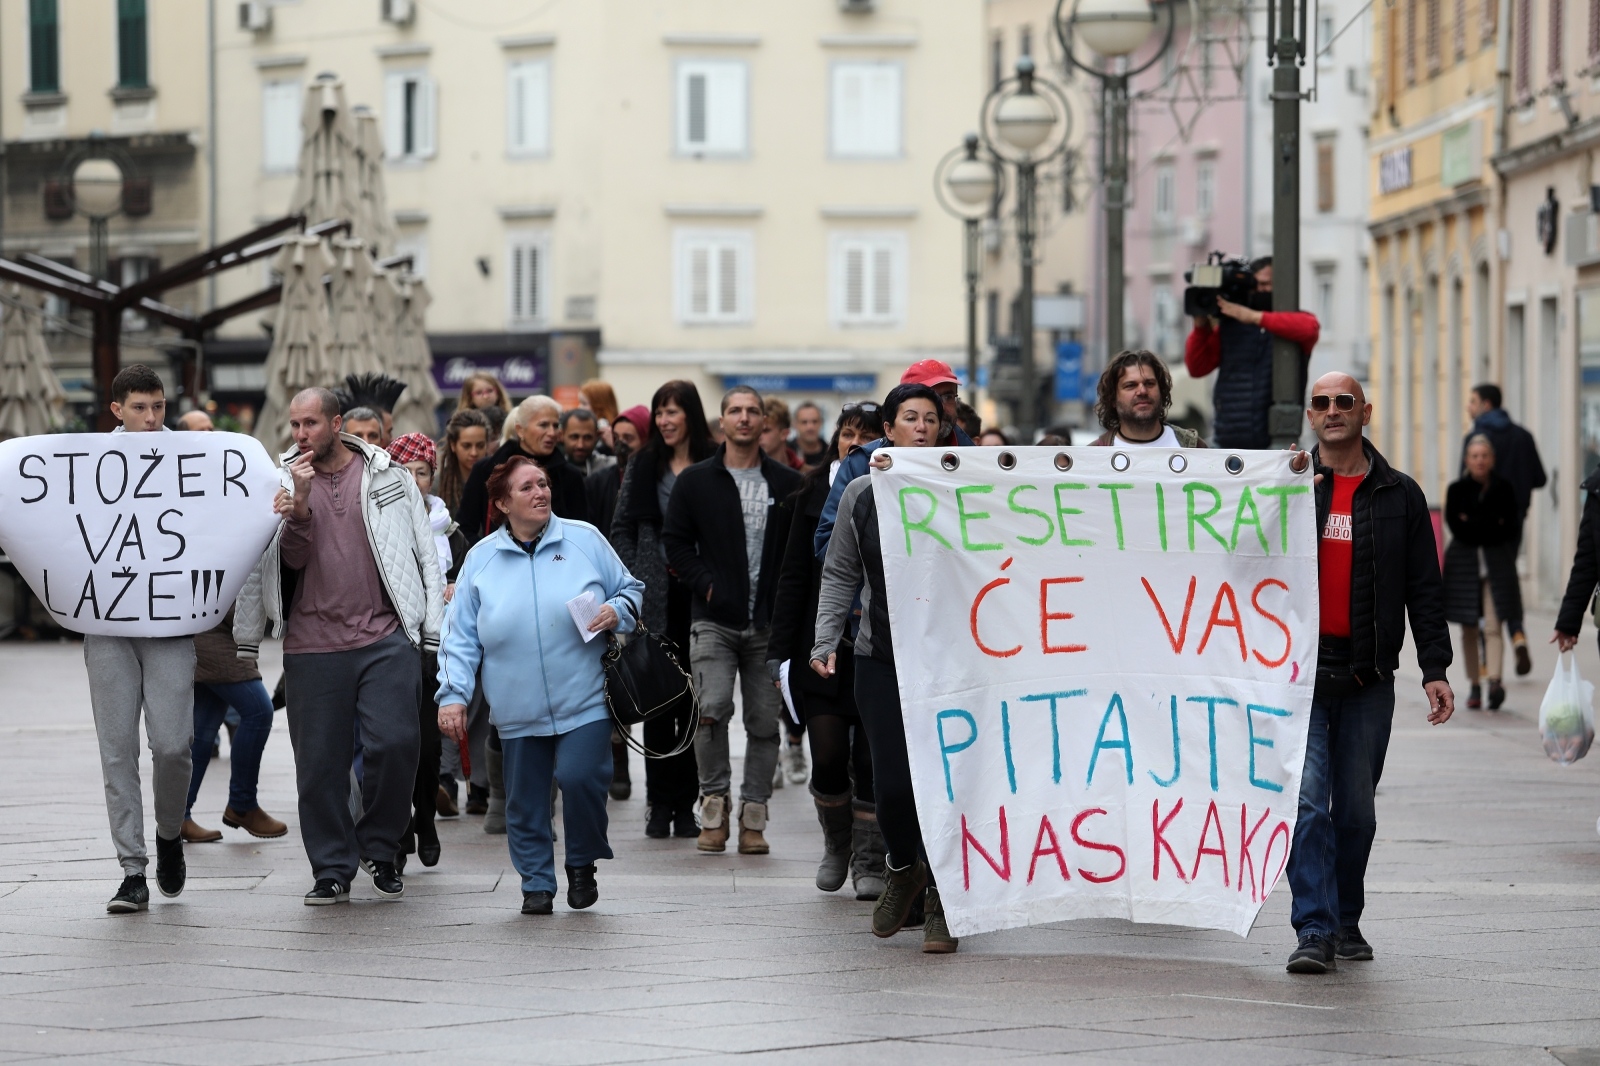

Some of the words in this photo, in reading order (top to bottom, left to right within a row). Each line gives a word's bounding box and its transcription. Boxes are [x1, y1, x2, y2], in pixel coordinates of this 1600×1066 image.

[19, 448, 249, 504] STOŽER
[76, 509, 186, 564] VAS
[899, 482, 1310, 556] RESETIRAT
[43, 566, 225, 621] LAŽE!!!
[970, 557, 1088, 658] ĆE
[1141, 575, 1299, 683] VAS,
[936, 689, 1293, 802] PITAJTE
[961, 805, 1127, 891] NAS
[1153, 798, 1290, 902] KAKO
